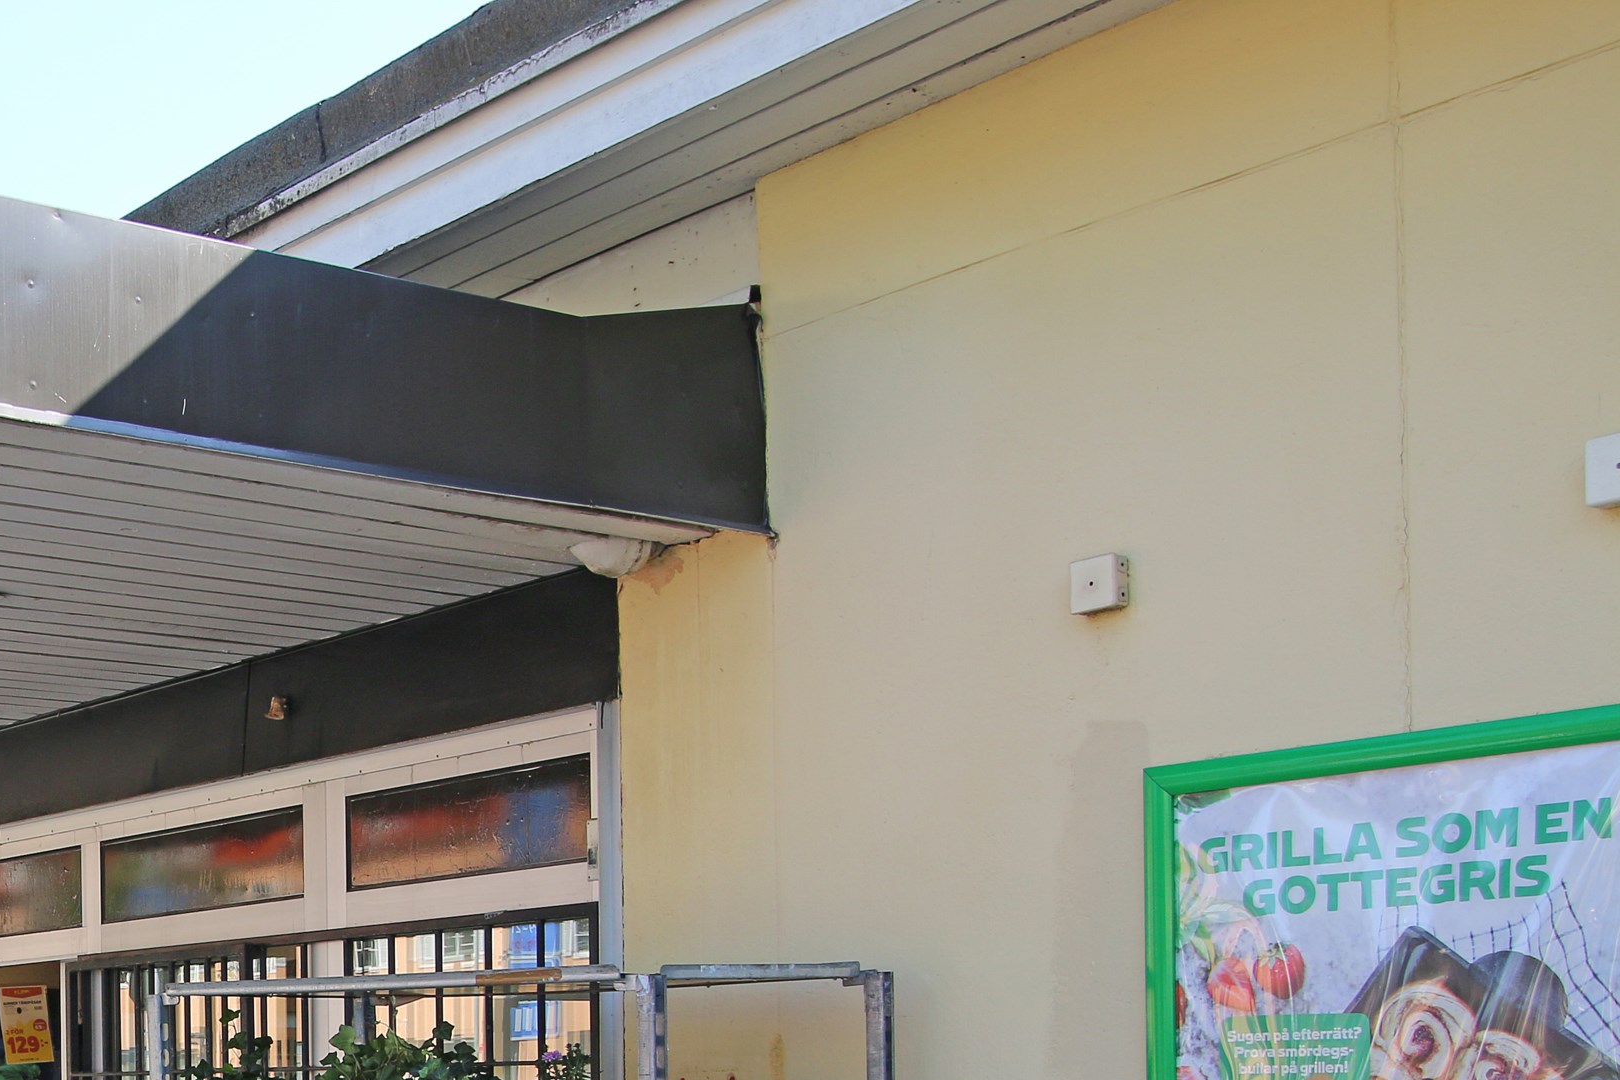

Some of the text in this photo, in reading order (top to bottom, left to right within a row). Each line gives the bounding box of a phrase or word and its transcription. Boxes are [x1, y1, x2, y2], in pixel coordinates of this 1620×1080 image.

[1198, 797, 1612, 874] GRILLA SOM EN
[1242, 854, 1551, 917] GOTTEGRIS
[1227, 1026, 1362, 1044] Sugen på efterrätt?
[1234, 1045, 1355, 1059] Prova smördegs-
[1239, 1061, 1349, 1076] bullar på grillen!
